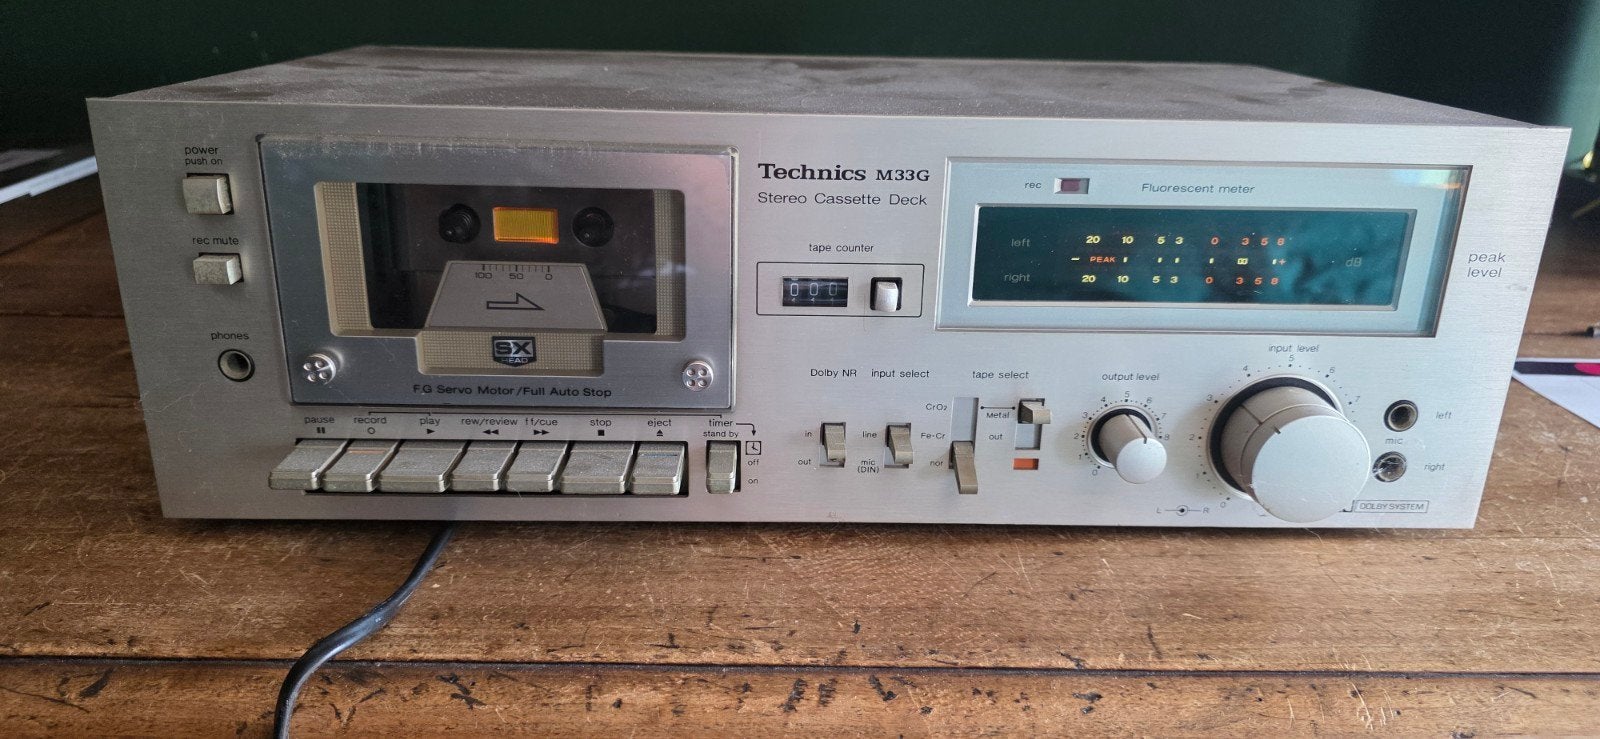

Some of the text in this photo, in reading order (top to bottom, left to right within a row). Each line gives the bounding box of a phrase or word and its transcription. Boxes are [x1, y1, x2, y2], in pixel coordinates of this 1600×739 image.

[184, 145, 218, 155] power
[185, 156, 208, 166] push
[758, 163, 930, 182] Technics M33G
[1142, 183, 1256, 194] Fluorescent meter
[758, 192, 928, 206] Stereo Cassette Deck
[192, 236, 239, 245] rec mute
[1011, 238, 1030, 248] left
[1086, 236, 1285, 246] 20 10 5 3 0 3 5 8
[809, 244, 874, 252] tape counter
[1345, 257, 1362, 268] dB
[1468, 252, 1506, 264] peak
[1004, 272, 1030, 283] right
[1467, 267, 1502, 278] level
[1082, 274, 1280, 286] 20 10 5 3 0 3 5 8
[210, 331, 250, 340] phones
[496, 341, 532, 355] SX
[1268, 344, 1292, 353] input
[810, 368, 838, 379] Dolby
[872, 369, 930, 378] input select
[972, 370, 1030, 379] tape select
[437, 385, 472, 394] Servo
[550, 387, 579, 397] Auto
[583, 388, 612, 398] Stop
[354, 416, 387, 424] record
[1436, 411, 1452, 420] left
[420, 417, 440, 426] play
[461, 418, 518, 426] rew/review
[590, 418, 612, 426] stop
[648, 418, 672, 427] eject
[708, 418, 733, 426] timer
[729, 430, 738, 438] by
[1424, 462, 1446, 472] right
